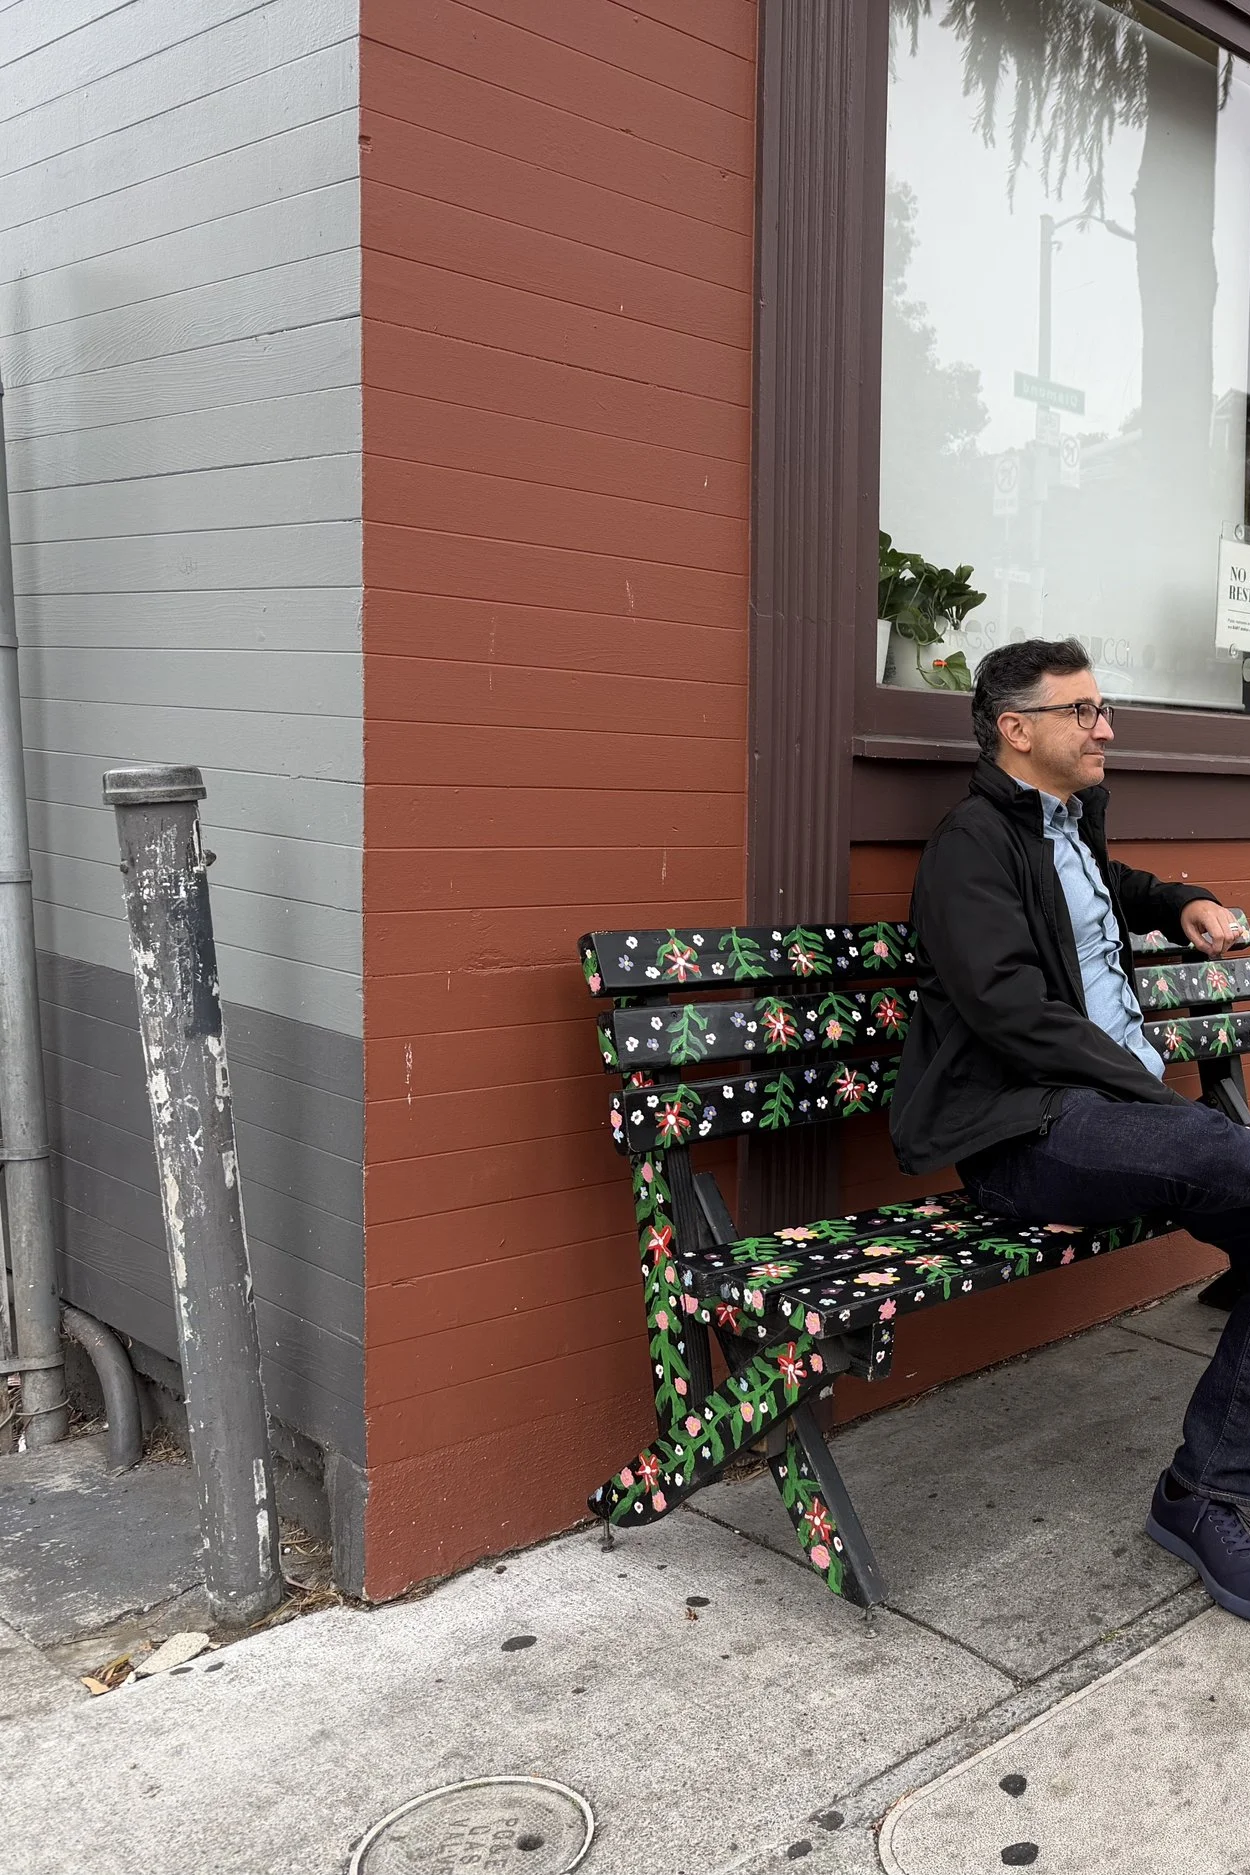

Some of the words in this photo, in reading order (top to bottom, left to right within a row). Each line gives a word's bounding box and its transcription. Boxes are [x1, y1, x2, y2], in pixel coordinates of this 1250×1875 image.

[1230, 566, 1247, 583] NO
[459, 1825, 491, 1865] GAS
[484, 1817, 519, 1870] PG&E
